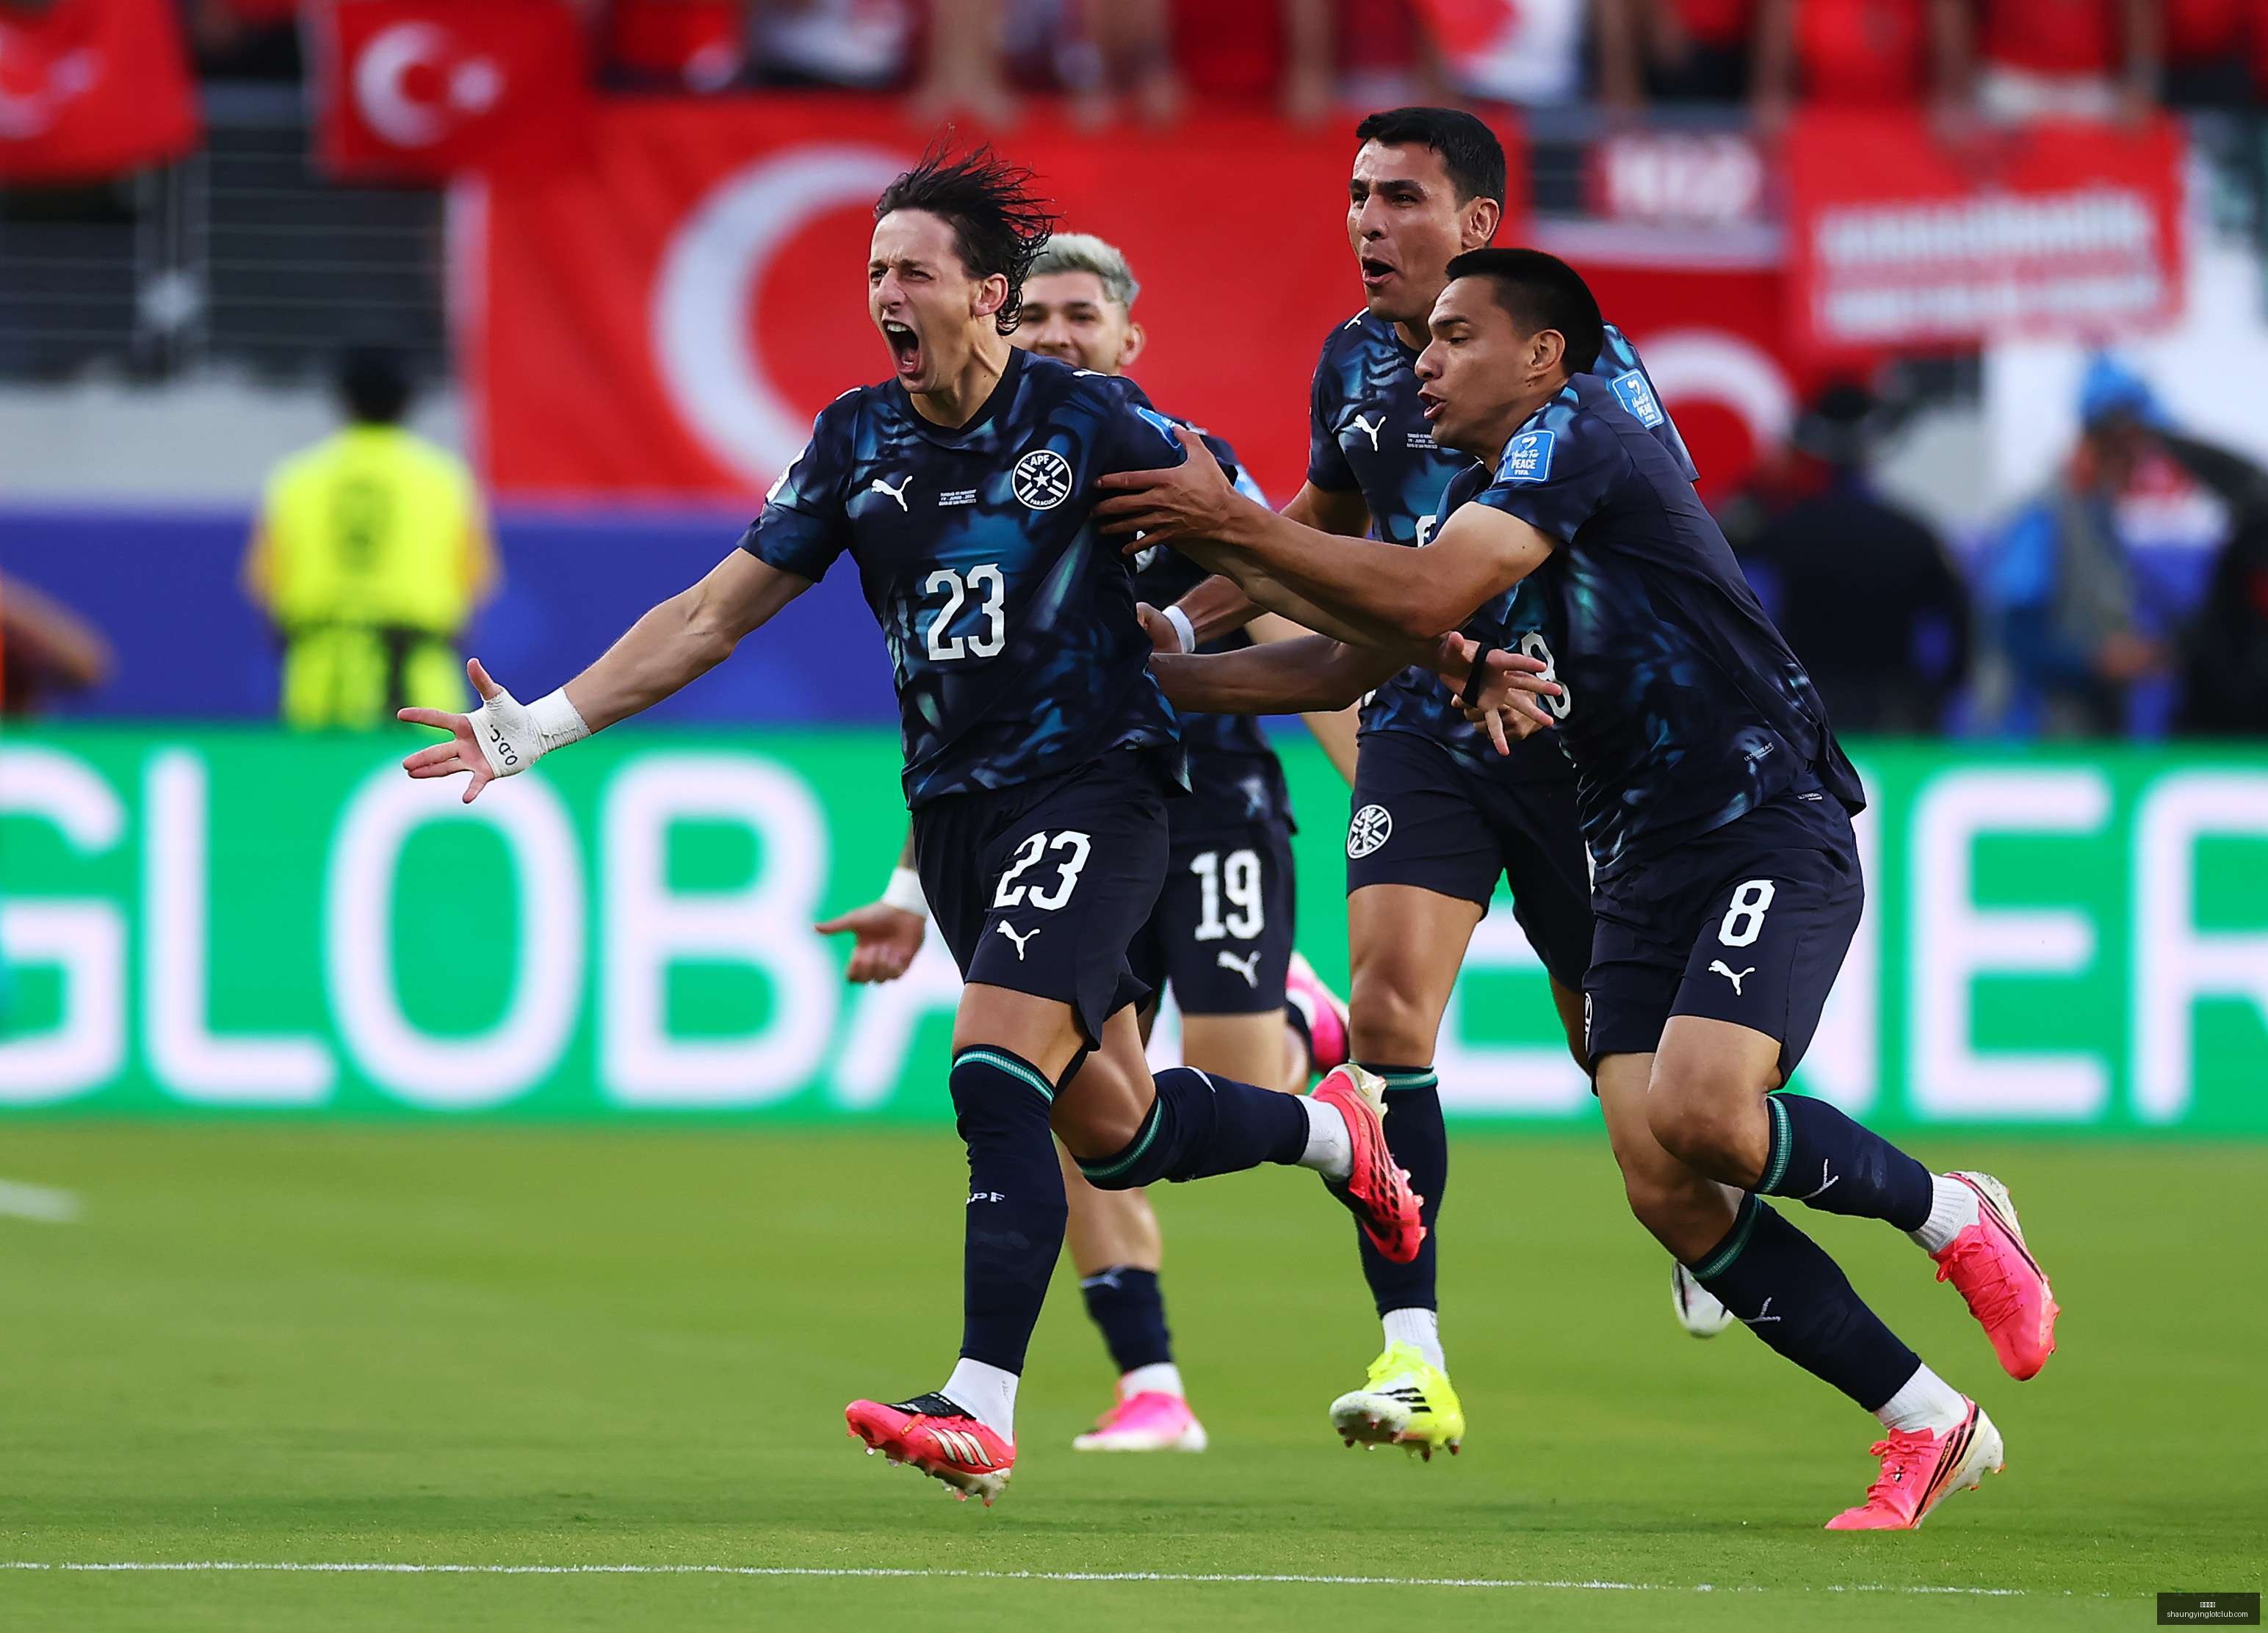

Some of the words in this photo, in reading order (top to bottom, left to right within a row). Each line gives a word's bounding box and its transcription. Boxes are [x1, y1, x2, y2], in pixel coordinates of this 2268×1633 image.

[1030, 455, 1050, 466] APF
[1511, 459, 1536, 469] PEACE
[1029, 496, 1058, 507] PARAGUAY
[925, 563, 1005, 661] 23
[993, 830, 1091, 910] 23
[1188, 849, 1265, 941] 19
[0, 743, 1182, 1110] GLOB
[1718, 879, 1776, 947] 8
[967, 1191, 1005, 1204] PF
